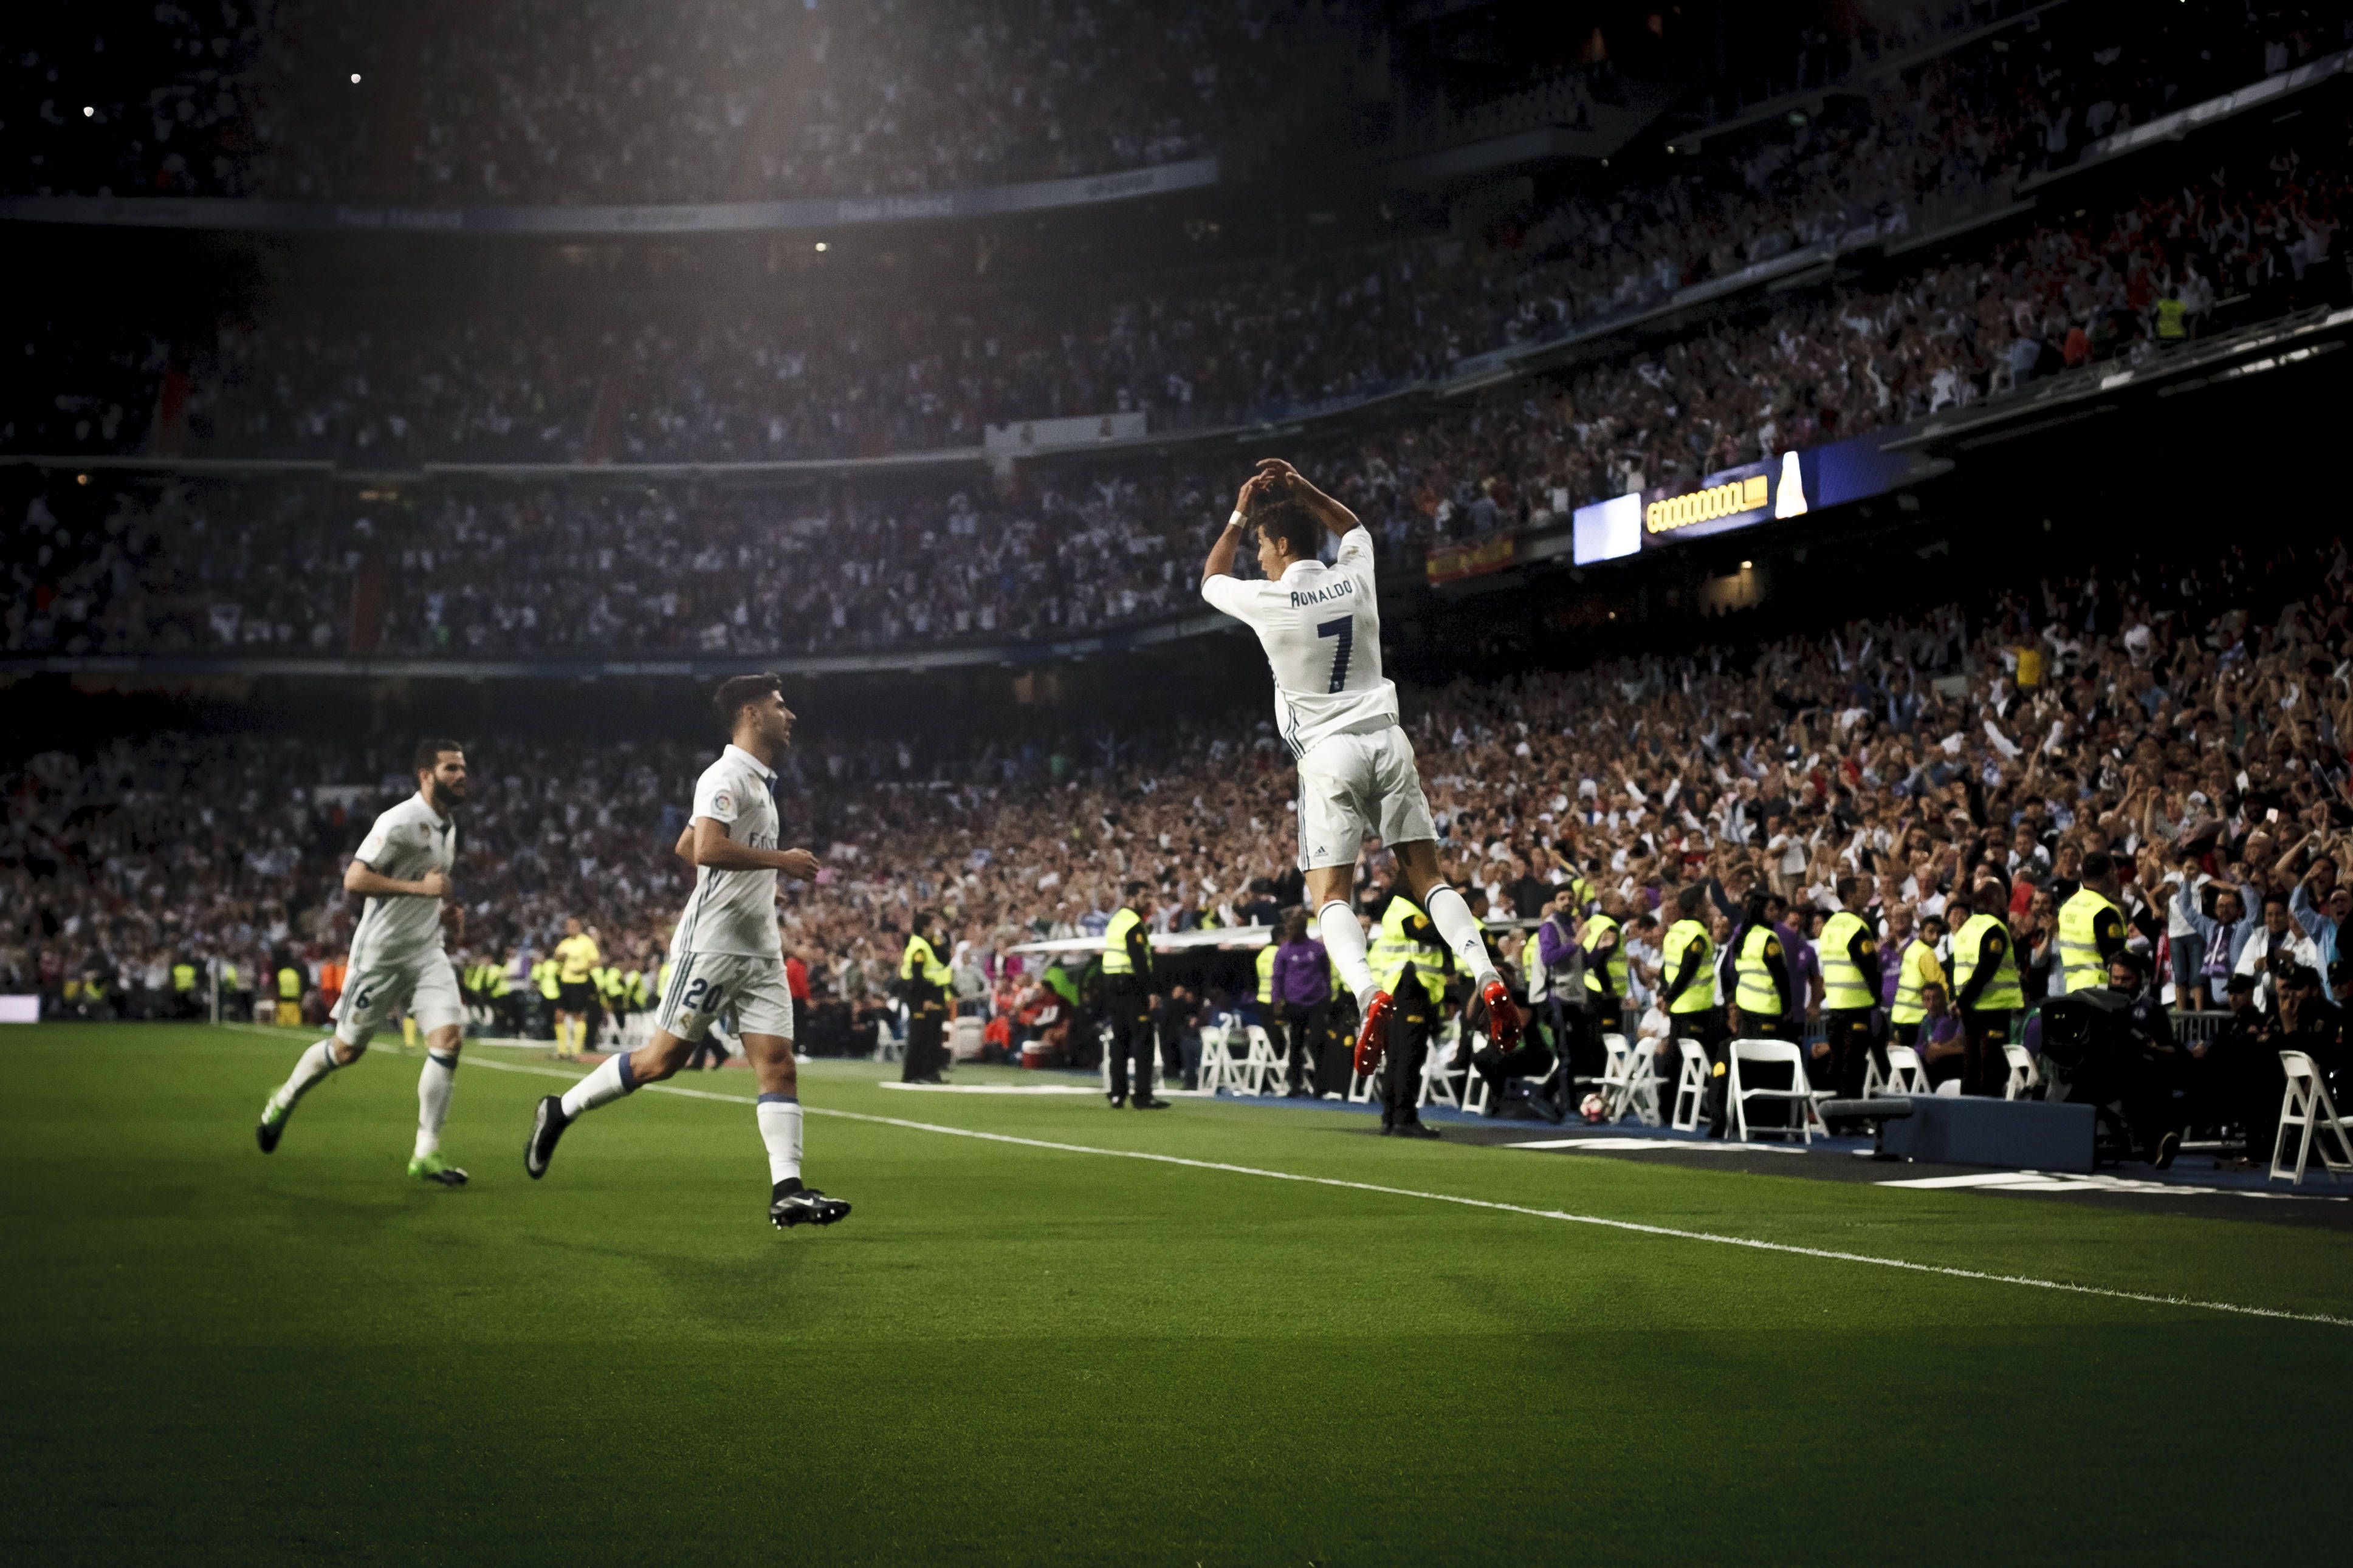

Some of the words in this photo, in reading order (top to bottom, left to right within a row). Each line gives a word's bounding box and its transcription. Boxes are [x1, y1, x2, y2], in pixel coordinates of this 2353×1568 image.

[1290, 580, 1353, 608] RONALDO
[1317, 615, 1353, 694] 7
[356, 985, 374, 1009] 6
[682, 977, 723, 1014] 20
